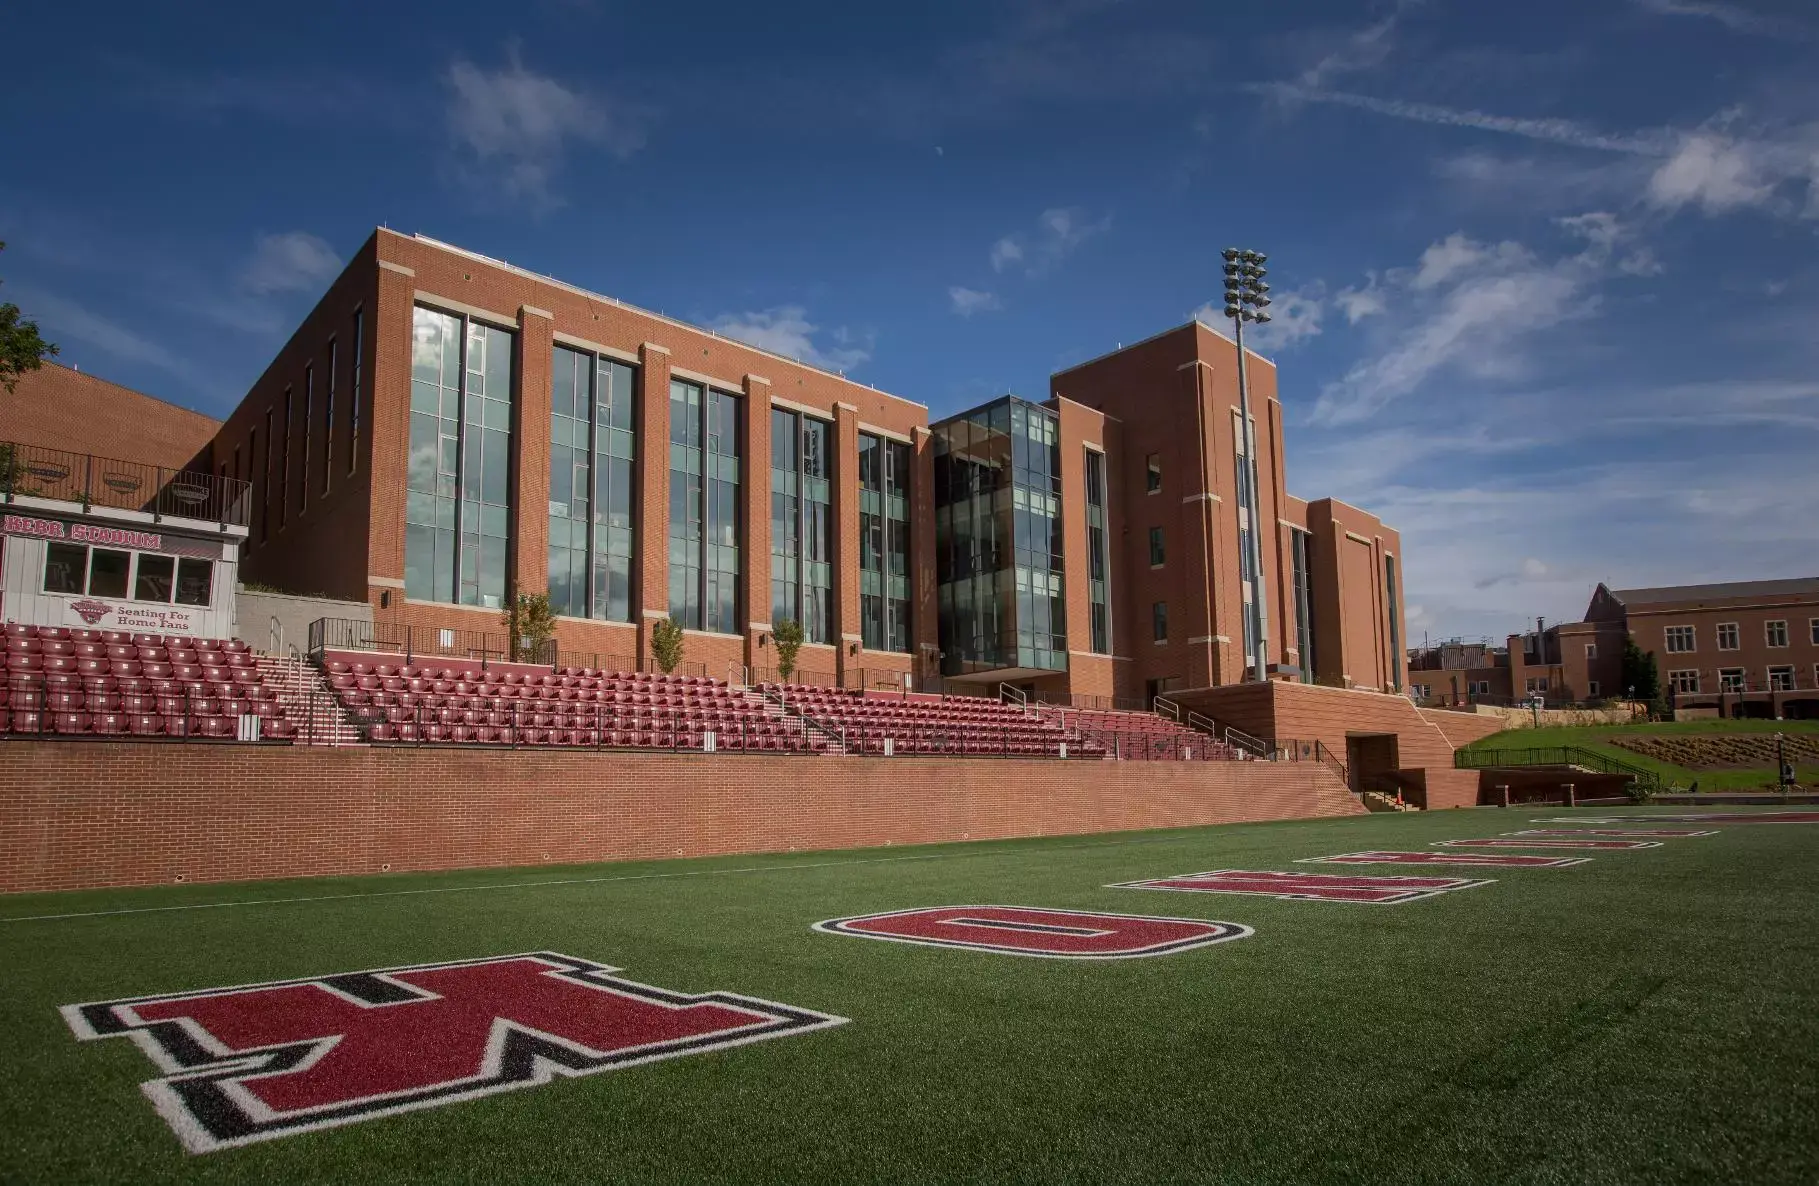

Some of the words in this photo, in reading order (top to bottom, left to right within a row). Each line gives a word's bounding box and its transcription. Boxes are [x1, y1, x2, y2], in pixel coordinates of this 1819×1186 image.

[4, 514, 64, 538] KERR
[71, 523, 161, 549] STADIUM
[118, 606, 166, 620] Seating
[170, 611, 190, 621] For
[118, 616, 157, 627] Home
[159, 620, 189, 630] Fans
